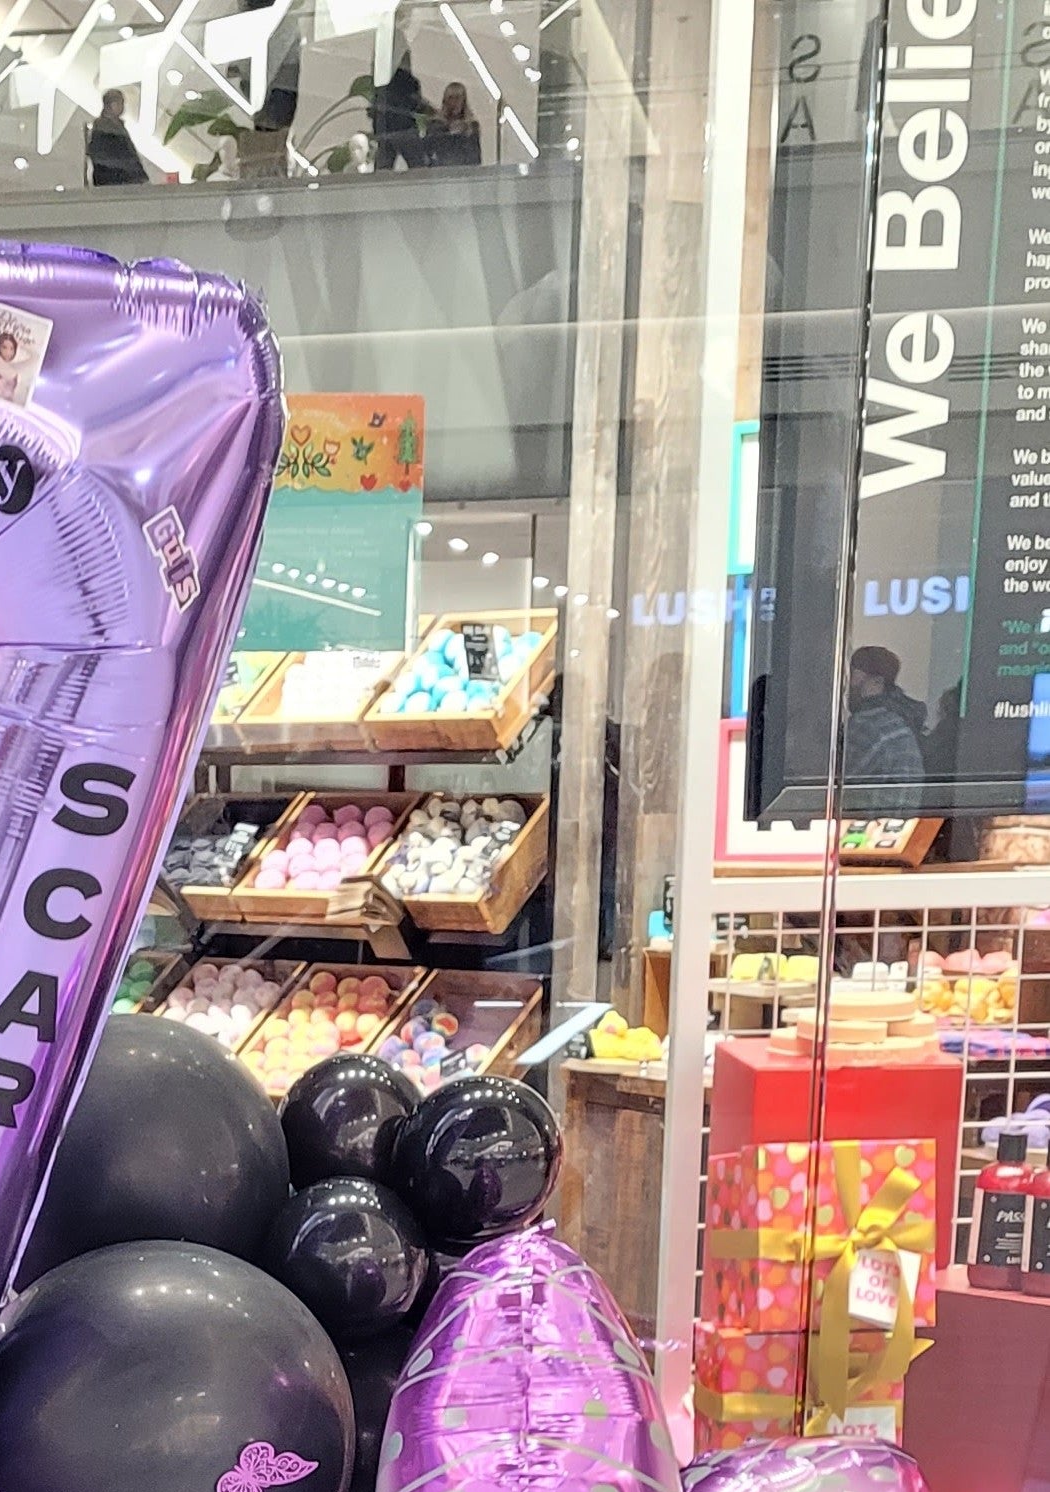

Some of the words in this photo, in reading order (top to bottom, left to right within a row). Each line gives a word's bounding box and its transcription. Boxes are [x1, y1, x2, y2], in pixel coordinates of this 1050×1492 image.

[1020, 340, 1050, 356] sha
[859, 311, 955, 499] We
[1015, 404, 1046, 422] and
[1009, 492, 1039, 508] and
[1006, 534, 1031, 551] We
[1004, 556, 1048, 574] enjoy
[1003, 577, 1029, 593] the
[856, 1288, 897, 1308] LOVE
